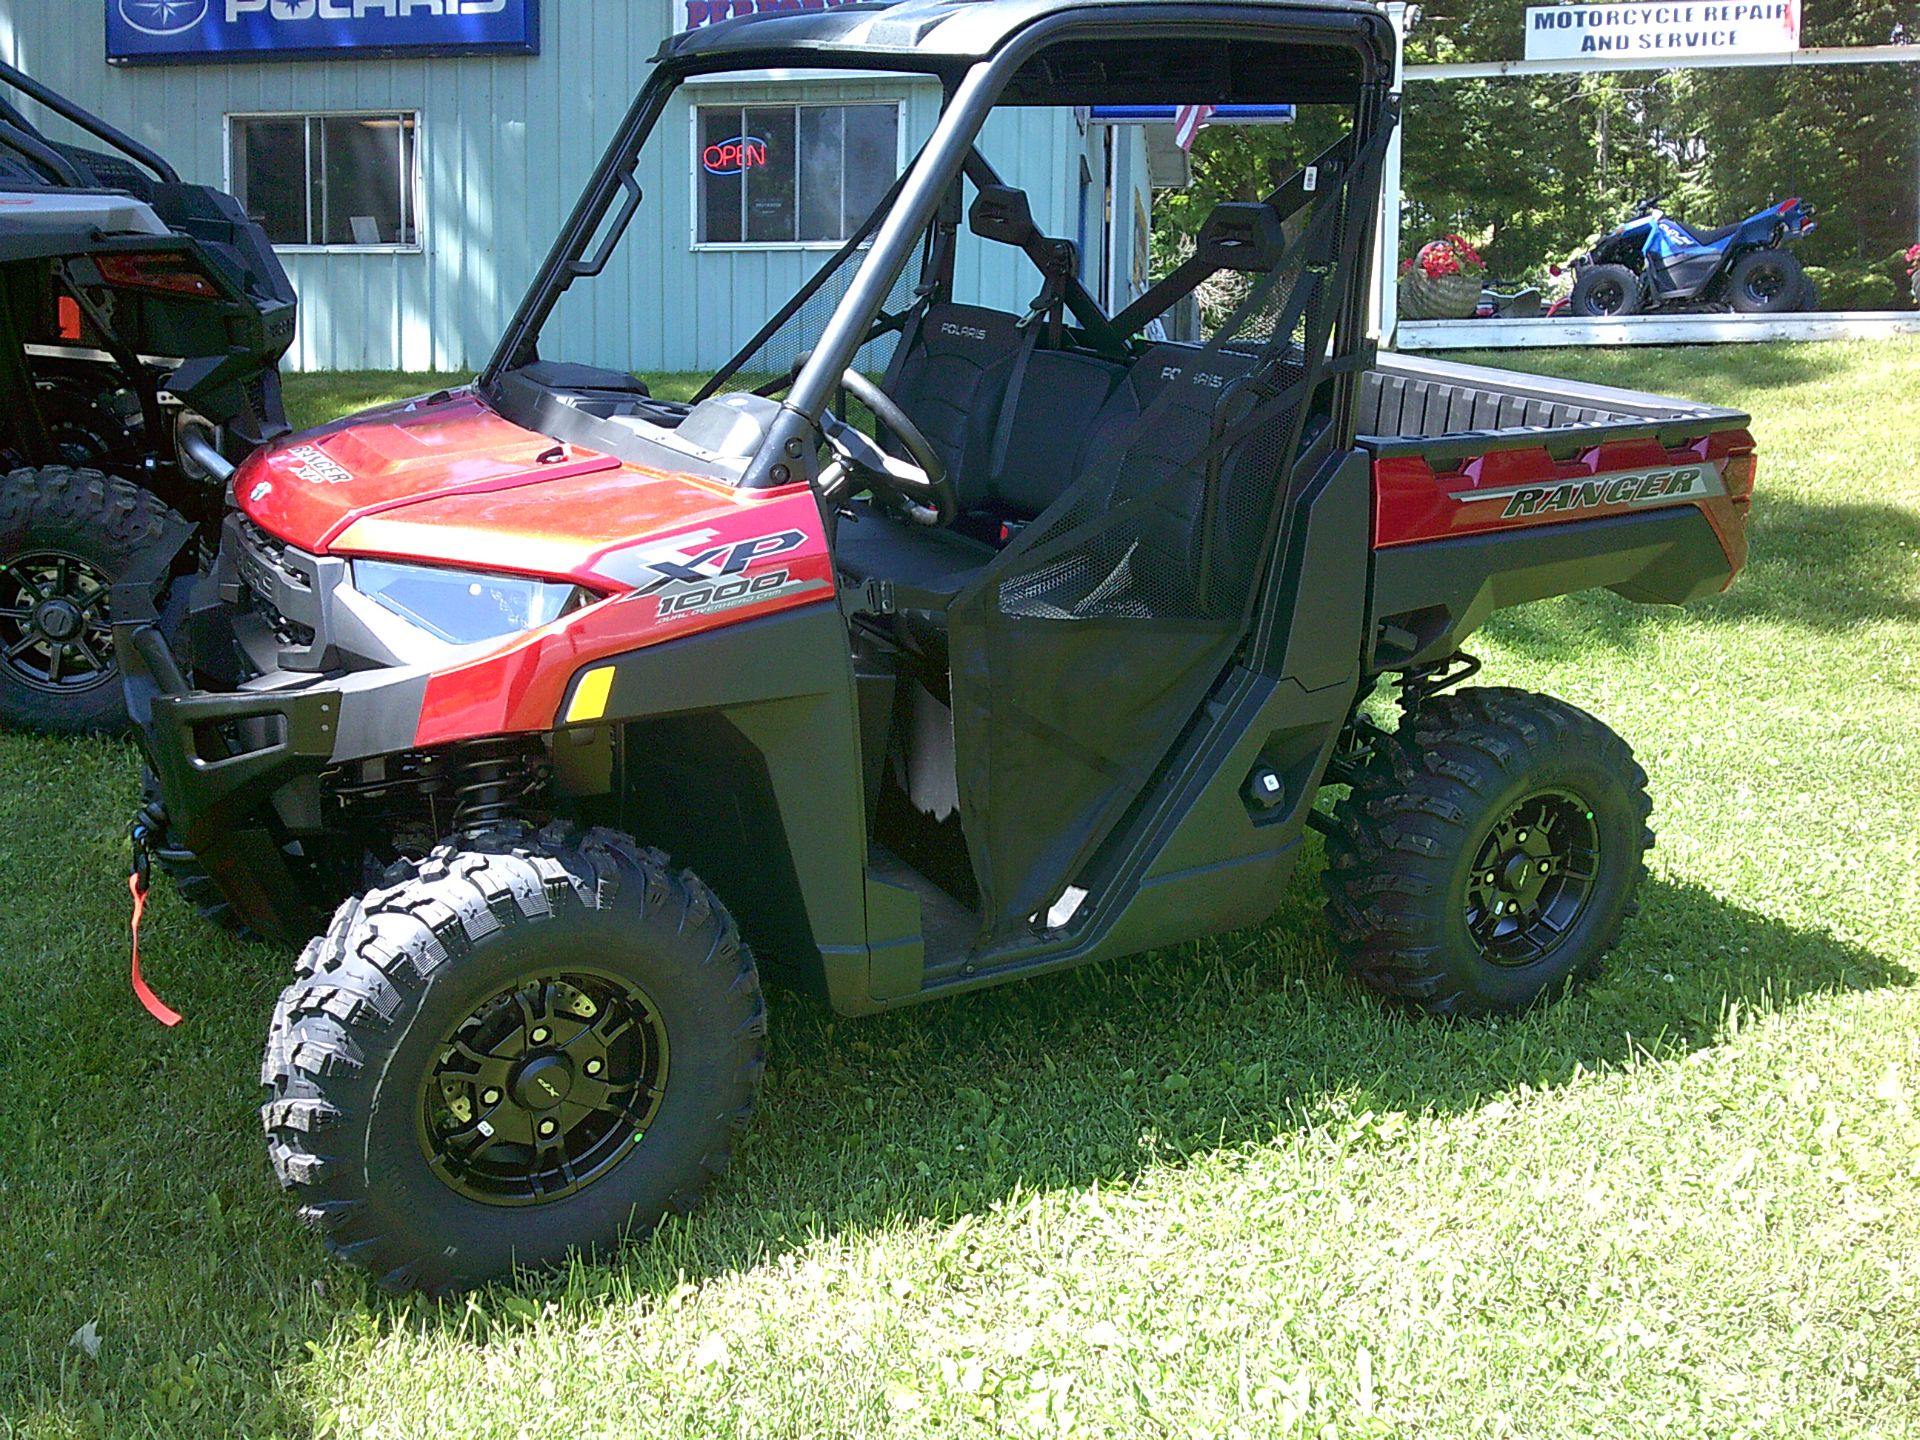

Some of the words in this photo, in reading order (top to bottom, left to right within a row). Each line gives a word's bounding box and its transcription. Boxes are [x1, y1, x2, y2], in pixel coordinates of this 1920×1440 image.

[1534, 7, 1694, 30] MOTORCYCLE
[1704, 3, 1791, 21] REPAIR
[1581, 34, 1629, 52] AND
[1638, 30, 1738, 50] SERVICE
[703, 143, 766, 169] OPEN
[941, 322, 986, 340] POLARIS
[1160, 366, 1223, 388] PORIS
[1501, 467, 1701, 518] RANGER
[620, 529, 808, 602] XP
[655, 610, 689, 625] DUAL
[690, 594, 754, 616] OVERHEAD
[755, 588, 783, 602] CAM
[656, 569, 789, 617] 1000
